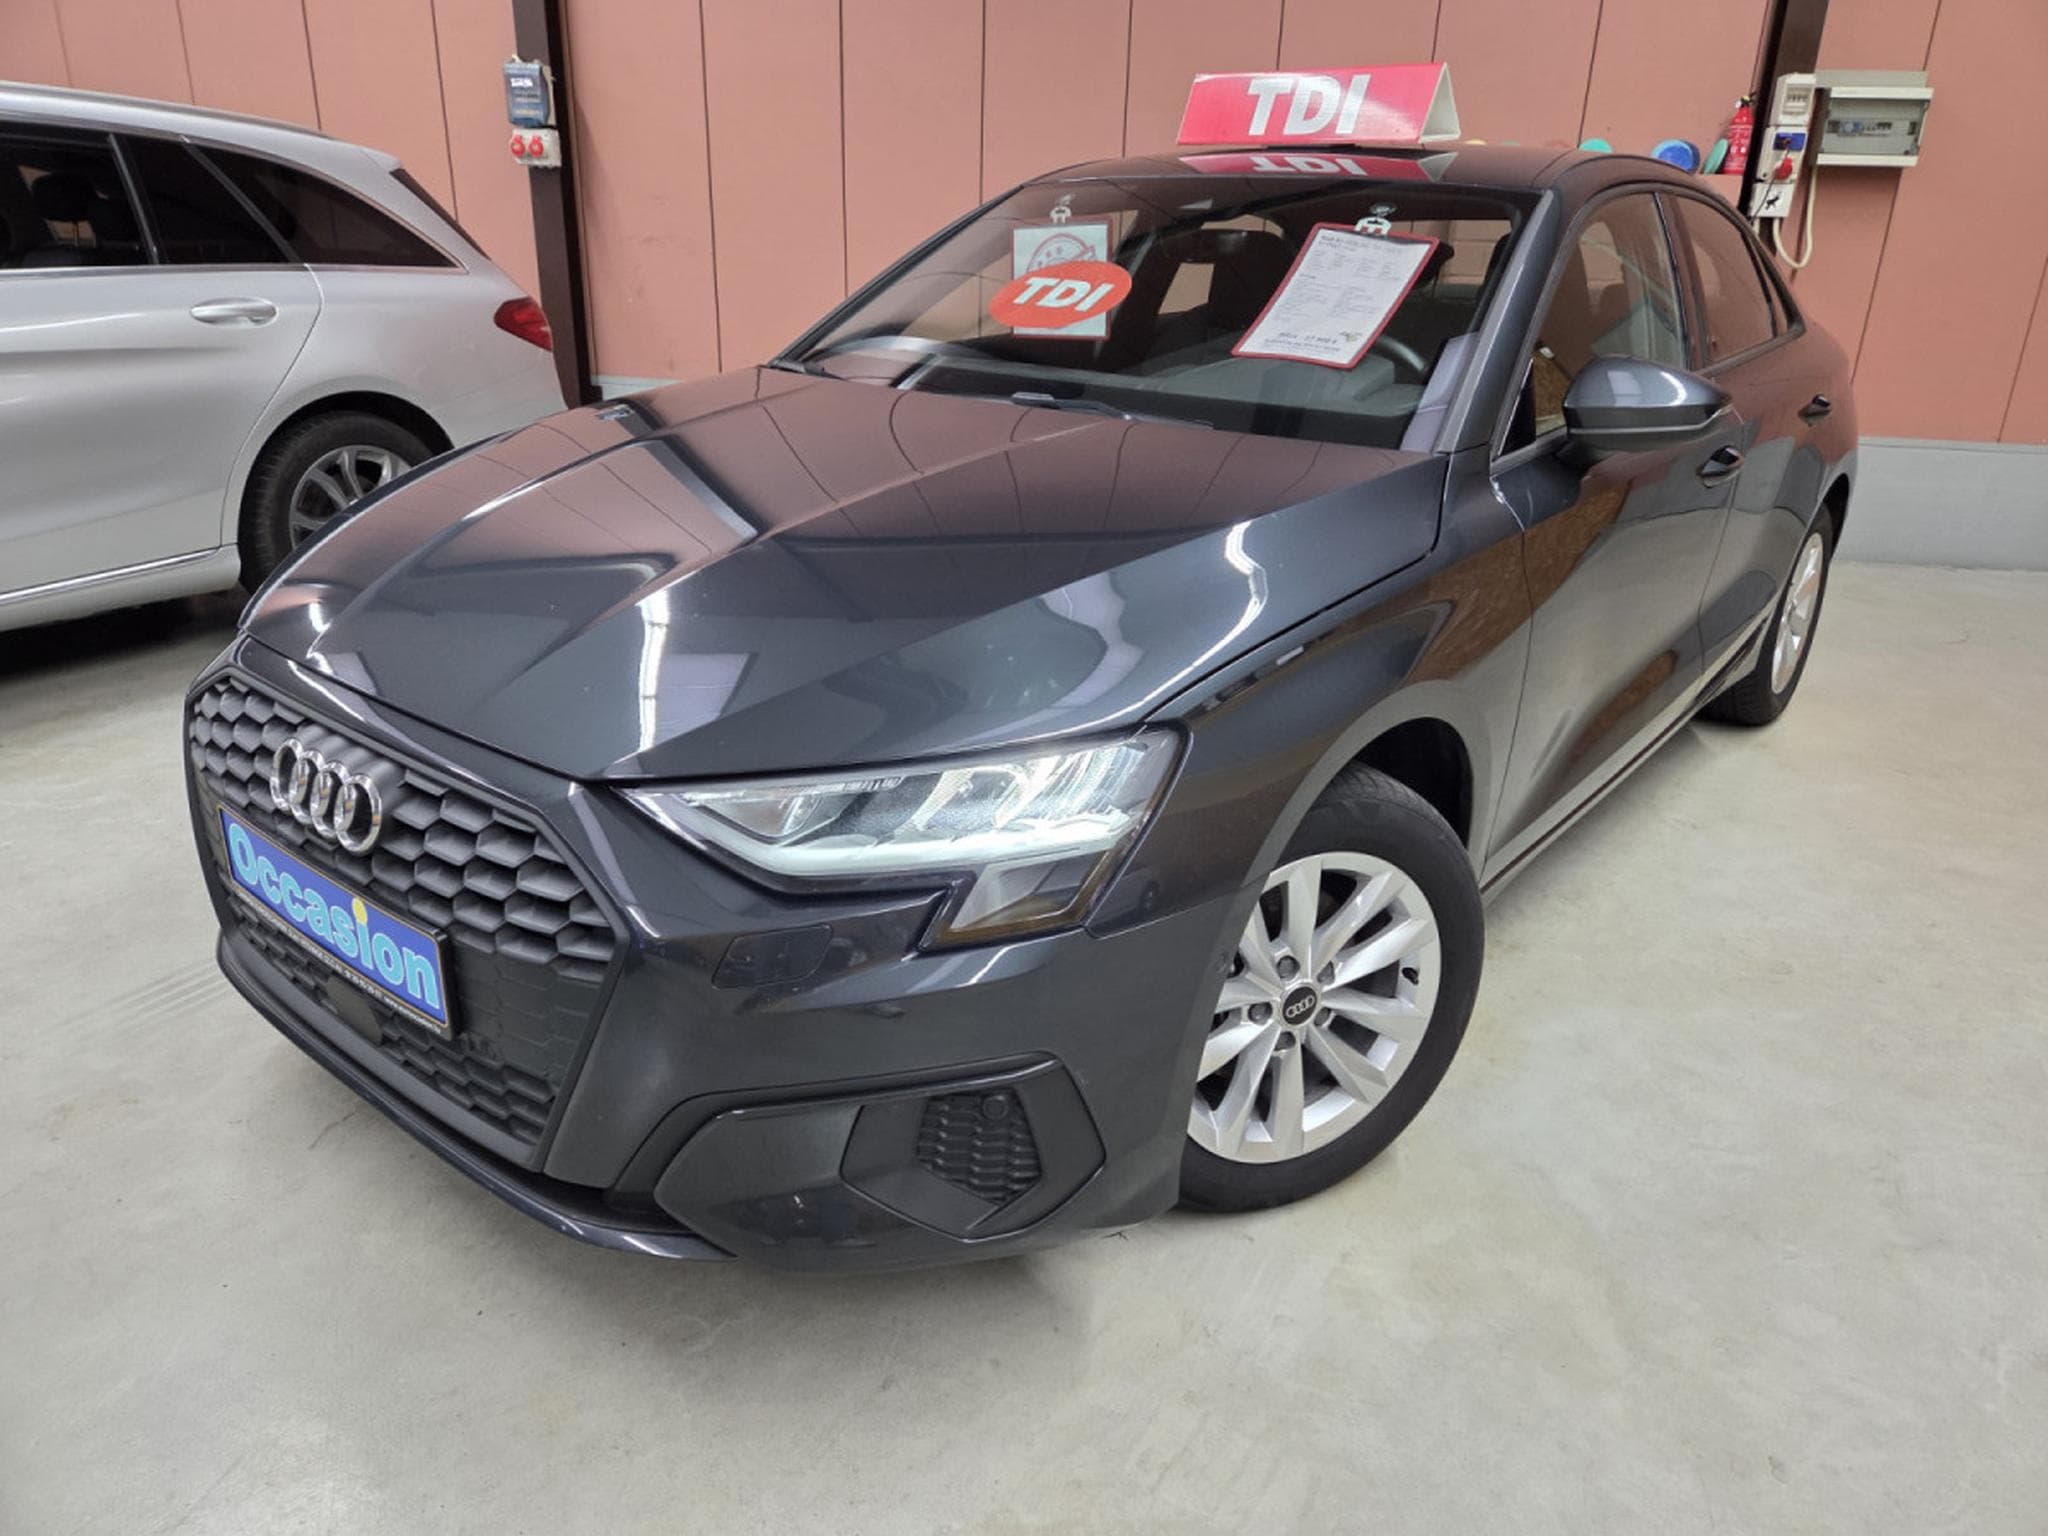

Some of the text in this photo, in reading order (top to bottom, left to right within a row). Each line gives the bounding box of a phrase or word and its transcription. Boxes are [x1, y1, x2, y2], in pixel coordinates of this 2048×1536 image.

[1247, 74, 1371, 136] TDI
[1013, 276, 1115, 312] TDI
[229, 822, 440, 1010] Occasion
